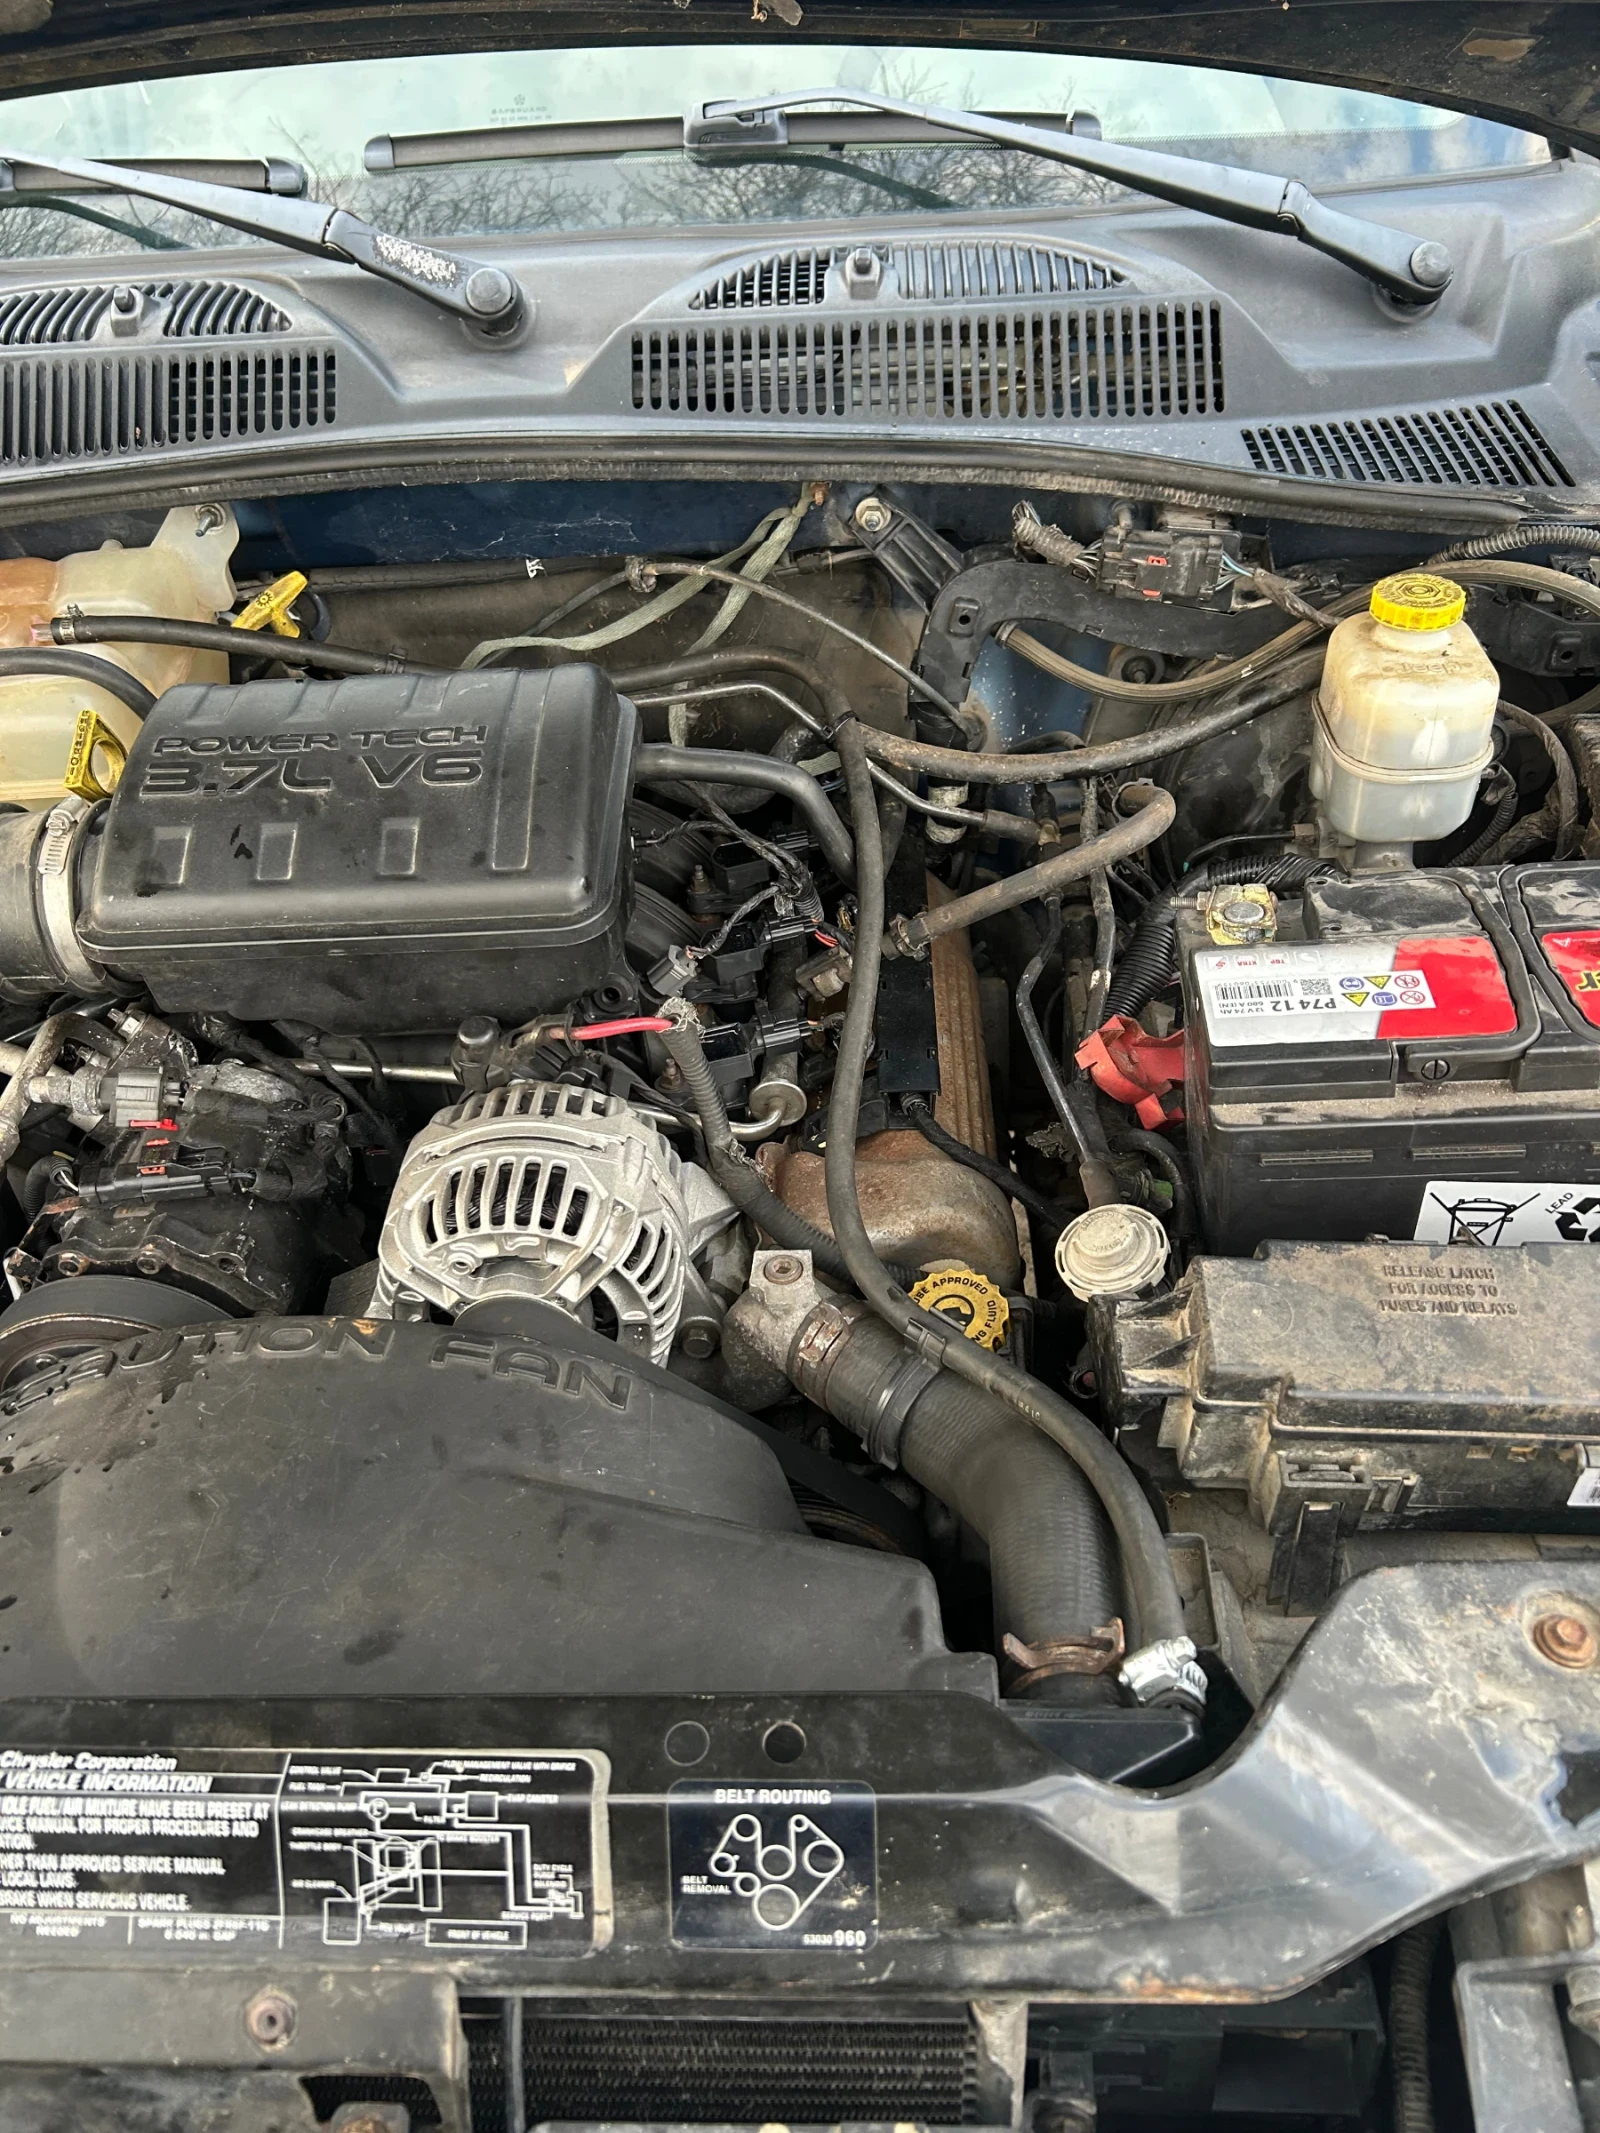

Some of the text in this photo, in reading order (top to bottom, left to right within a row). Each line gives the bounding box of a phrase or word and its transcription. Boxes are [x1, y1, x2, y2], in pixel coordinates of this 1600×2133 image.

[153, 724, 489, 756] POWER TECH
[140, 749, 486, 798] 3.7L V6
[1270, 997, 1337, 1012] P74 12
[1545, 1191, 1575, 1215] LEAD
[1450, 1265, 1496, 1280] LATCH
[1388, 1282, 1417, 1296] FOR
[1479, 1284, 1499, 1298] TO
[932, 1276, 989, 1296] APPROVED
[985, 1300, 997, 1328] FLUID
[1462, 1301, 1519, 1317] RELAYS
[4, 1320, 633, 1414] CAUTION FAN
[75, 1751, 178, 1773] Corporation
[5, 1772, 214, 1793] VEHICLE INFORMATION
[713, 1787, 832, 1805] BELT ROUTING
[207, 1801, 252, 1821] PRESET
[152, 1818, 230, 1838] PROCEDURES
[231, 1820, 260, 1839] AND
[60, 1854, 121, 1873] APPROVED
[122, 1855, 173, 1874] SERVICE
[681, 1875, 708, 1884] BELT
[682, 1884, 732, 1894] REMOVAL
